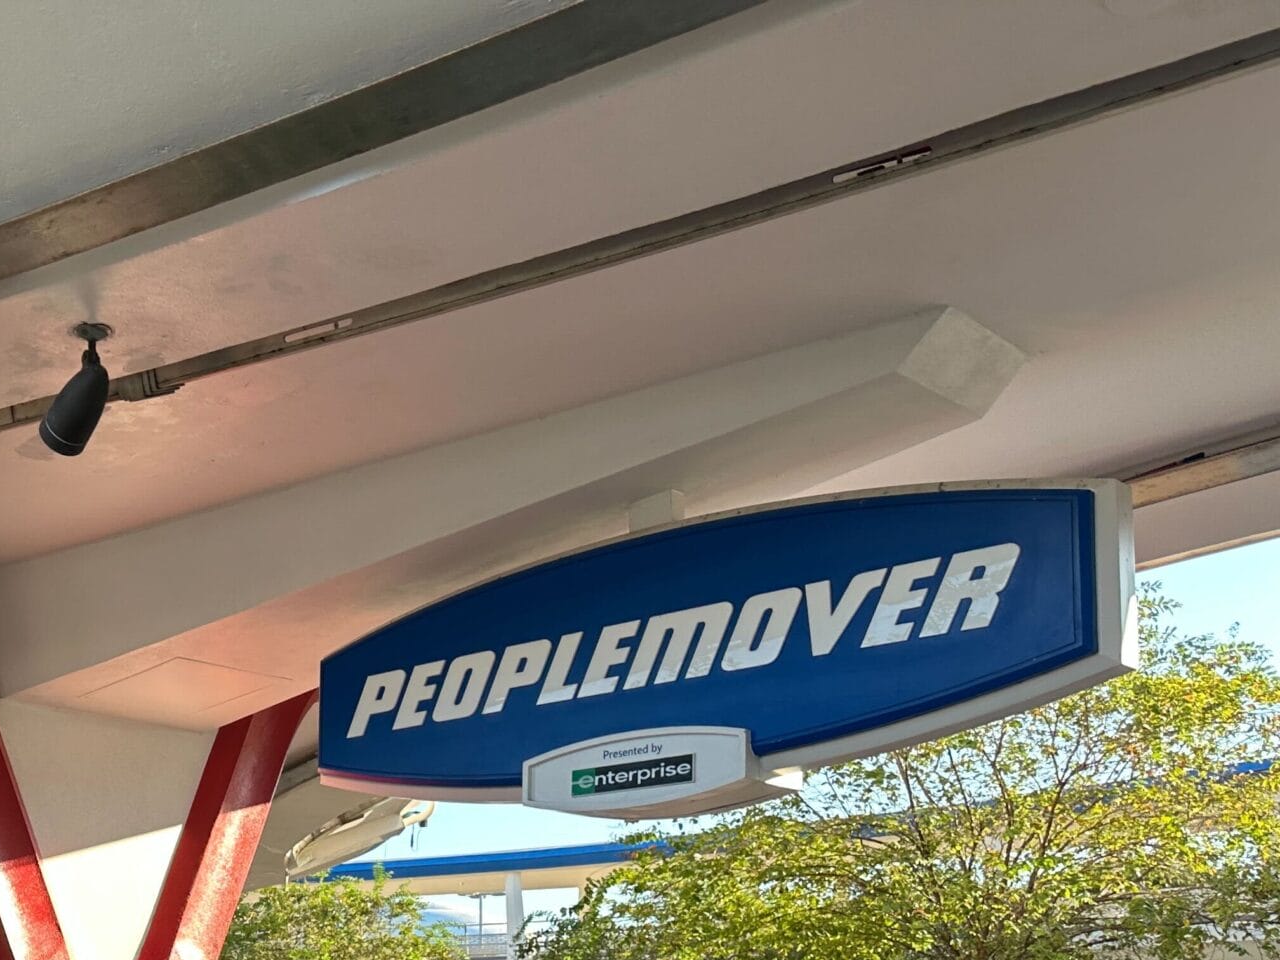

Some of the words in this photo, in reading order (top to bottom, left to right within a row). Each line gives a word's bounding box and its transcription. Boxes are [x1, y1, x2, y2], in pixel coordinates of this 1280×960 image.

[345, 542, 1021, 739] PEOPLEMOVER
[603, 744, 649, 760] Presented
[651, 743, 663, 755] by
[576, 762, 691, 788] enterprise
